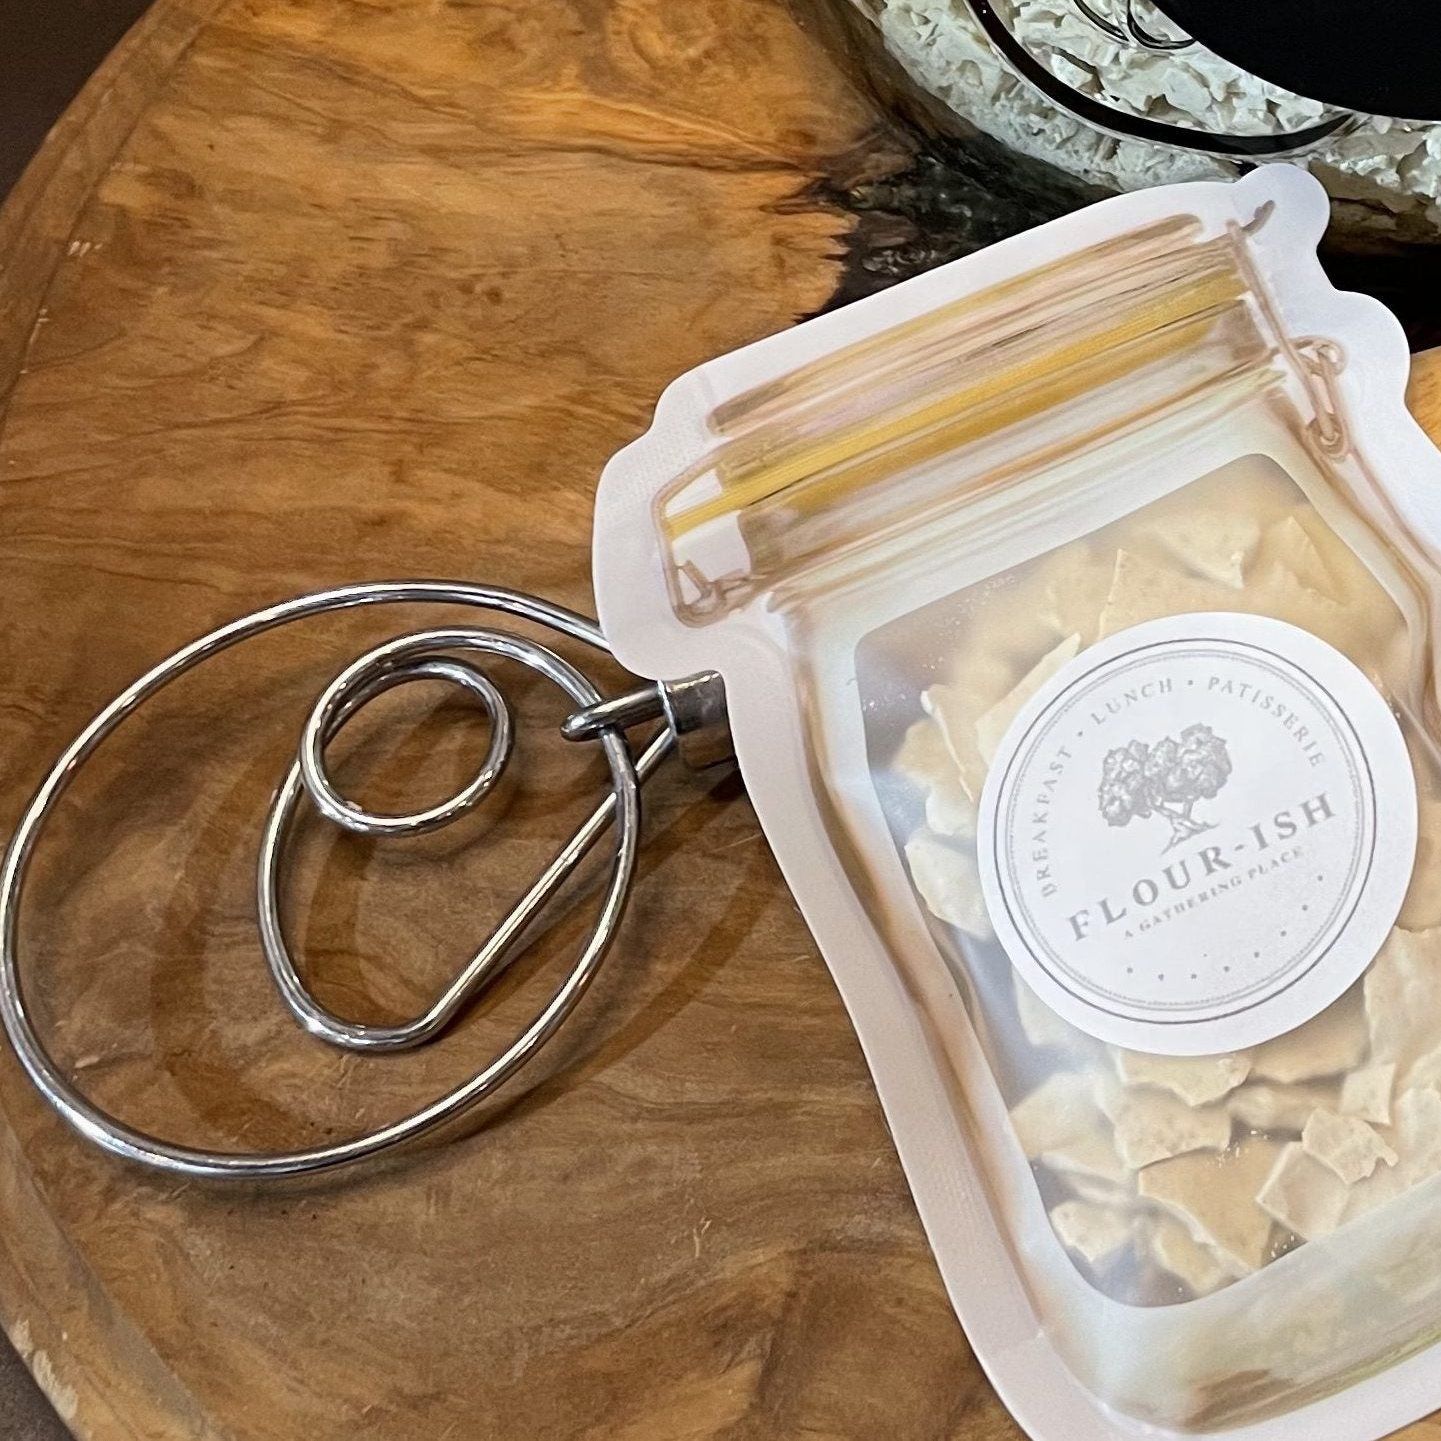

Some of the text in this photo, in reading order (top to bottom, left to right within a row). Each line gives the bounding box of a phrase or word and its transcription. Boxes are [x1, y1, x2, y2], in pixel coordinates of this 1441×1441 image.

[1032, 676, 1324, 898] BREAKFAST LUNCH PATISSERIE
[1068, 793, 1336, 941] FLOUR-ISH
[1124, 845, 1304, 938] A GATHERING PLACE
